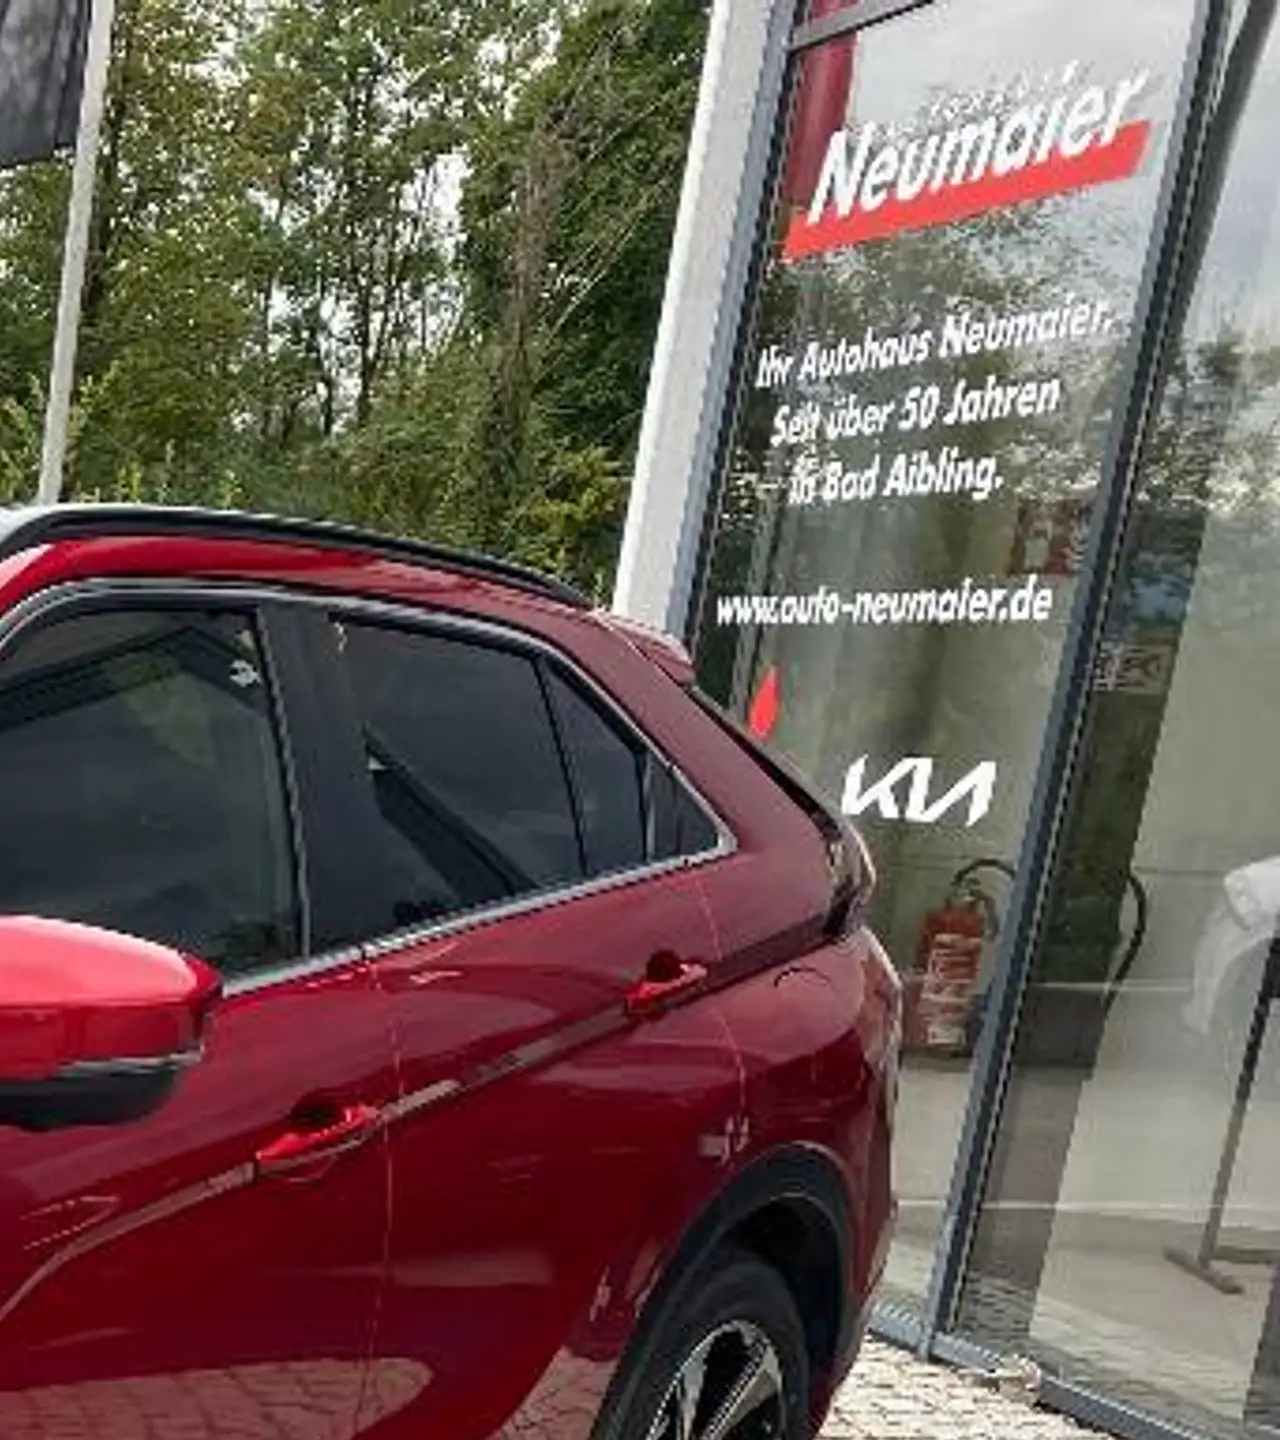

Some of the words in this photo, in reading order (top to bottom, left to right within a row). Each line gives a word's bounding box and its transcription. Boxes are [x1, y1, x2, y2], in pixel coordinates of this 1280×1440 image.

[806, 60, 1149, 226] Neumaier
[755, 345, 794, 389] Ihr
[797, 326, 932, 380] Autohaus
[771, 403, 820, 446] Seit
[827, 394, 895, 439] über
[898, 385, 940, 429] 50
[942, 374, 1060, 425] Jahren
[823, 453, 880, 502] Bad
[883, 446, 1003, 501] Aibling.
[716, 573, 1053, 625] www.auto-neumaier.de
[841, 754, 997, 828] KIA
